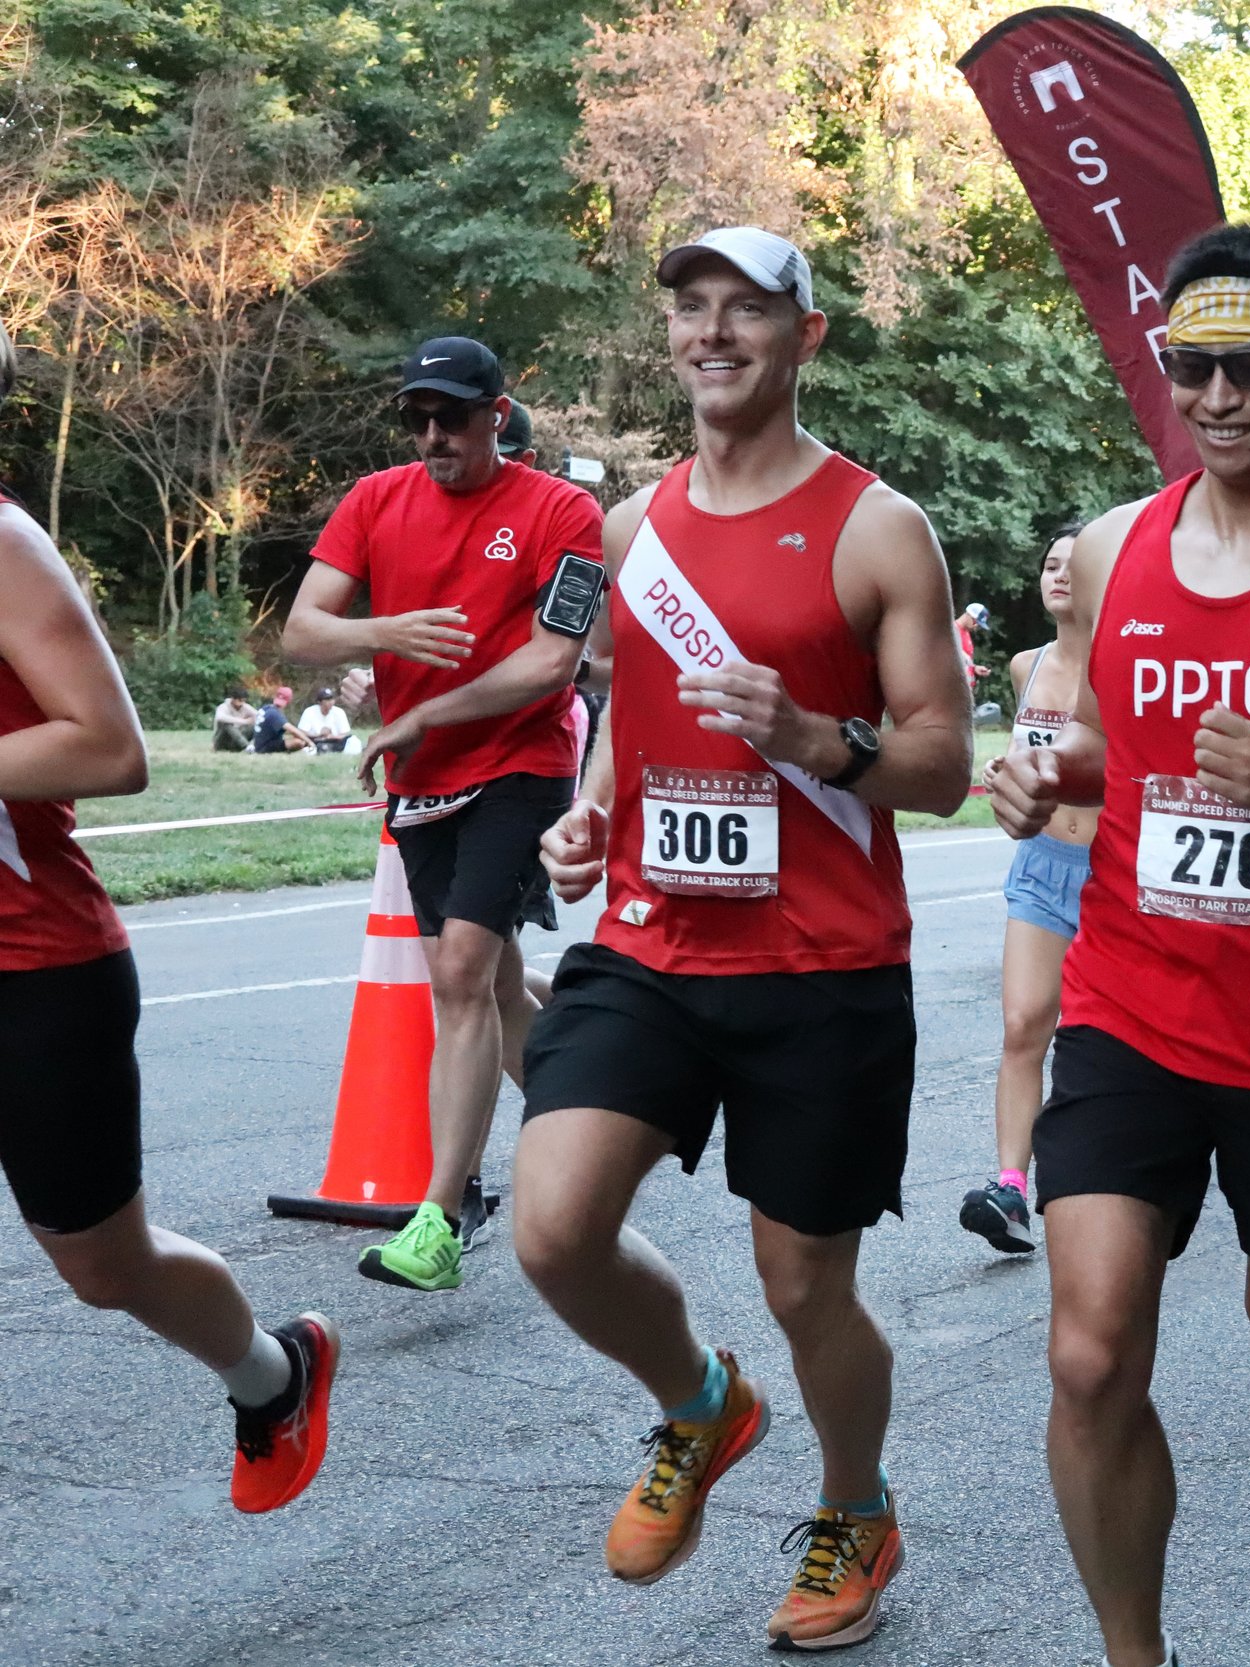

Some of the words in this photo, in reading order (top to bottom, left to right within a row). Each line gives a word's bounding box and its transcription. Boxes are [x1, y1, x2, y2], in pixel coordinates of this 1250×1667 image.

[643, 577, 724, 669] PROSP
[667, 776, 770, 791] GOLDSTEIN
[1151, 785, 1171, 796] AL
[672, 790, 698, 800] SPEED
[700, 791, 731, 802] SERIES
[747, 793, 773, 803] 2022
[1151, 798, 1190, 813] SUMMER
[1192, 803, 1224, 817] SPEED
[659, 808, 749, 867] 306
[647, 869, 680, 884] SPECT
[681, 874, 706, 886] PARK
[708, 875, 741, 887] TRACK
[742, 877, 770, 887] CLUB
[1144, 890, 1197, 908] PROSPECT
[1199, 899, 1228, 912] PARK
